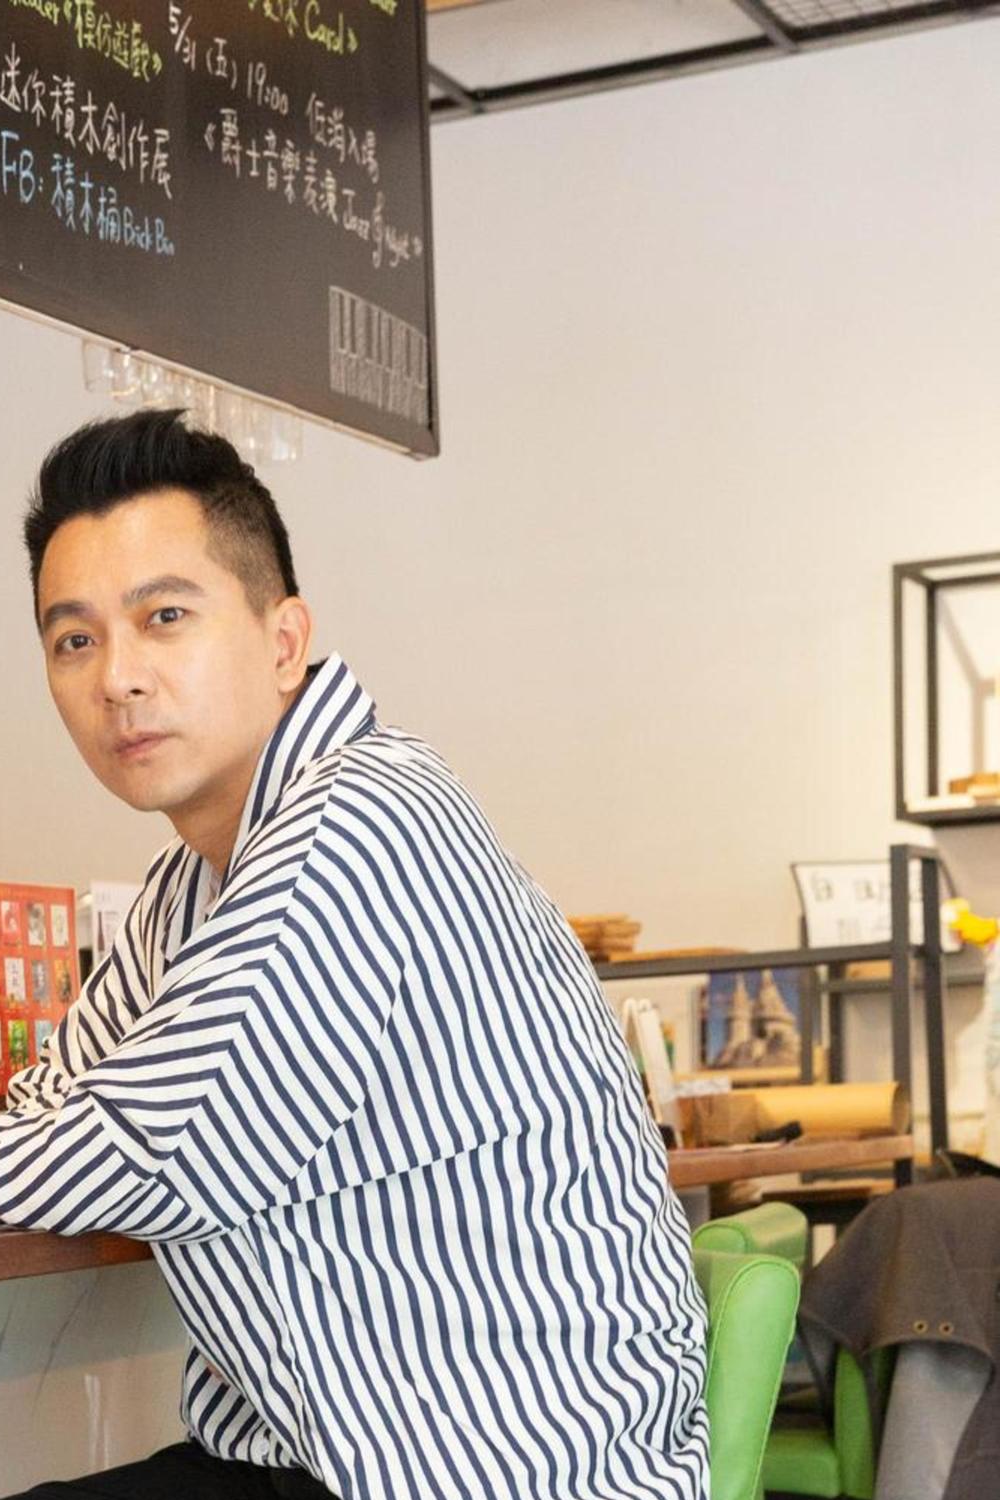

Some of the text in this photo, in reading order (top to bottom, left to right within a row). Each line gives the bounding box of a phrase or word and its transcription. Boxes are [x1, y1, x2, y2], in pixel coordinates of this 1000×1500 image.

[0, 42, 173, 200] 迷你積木創作展
